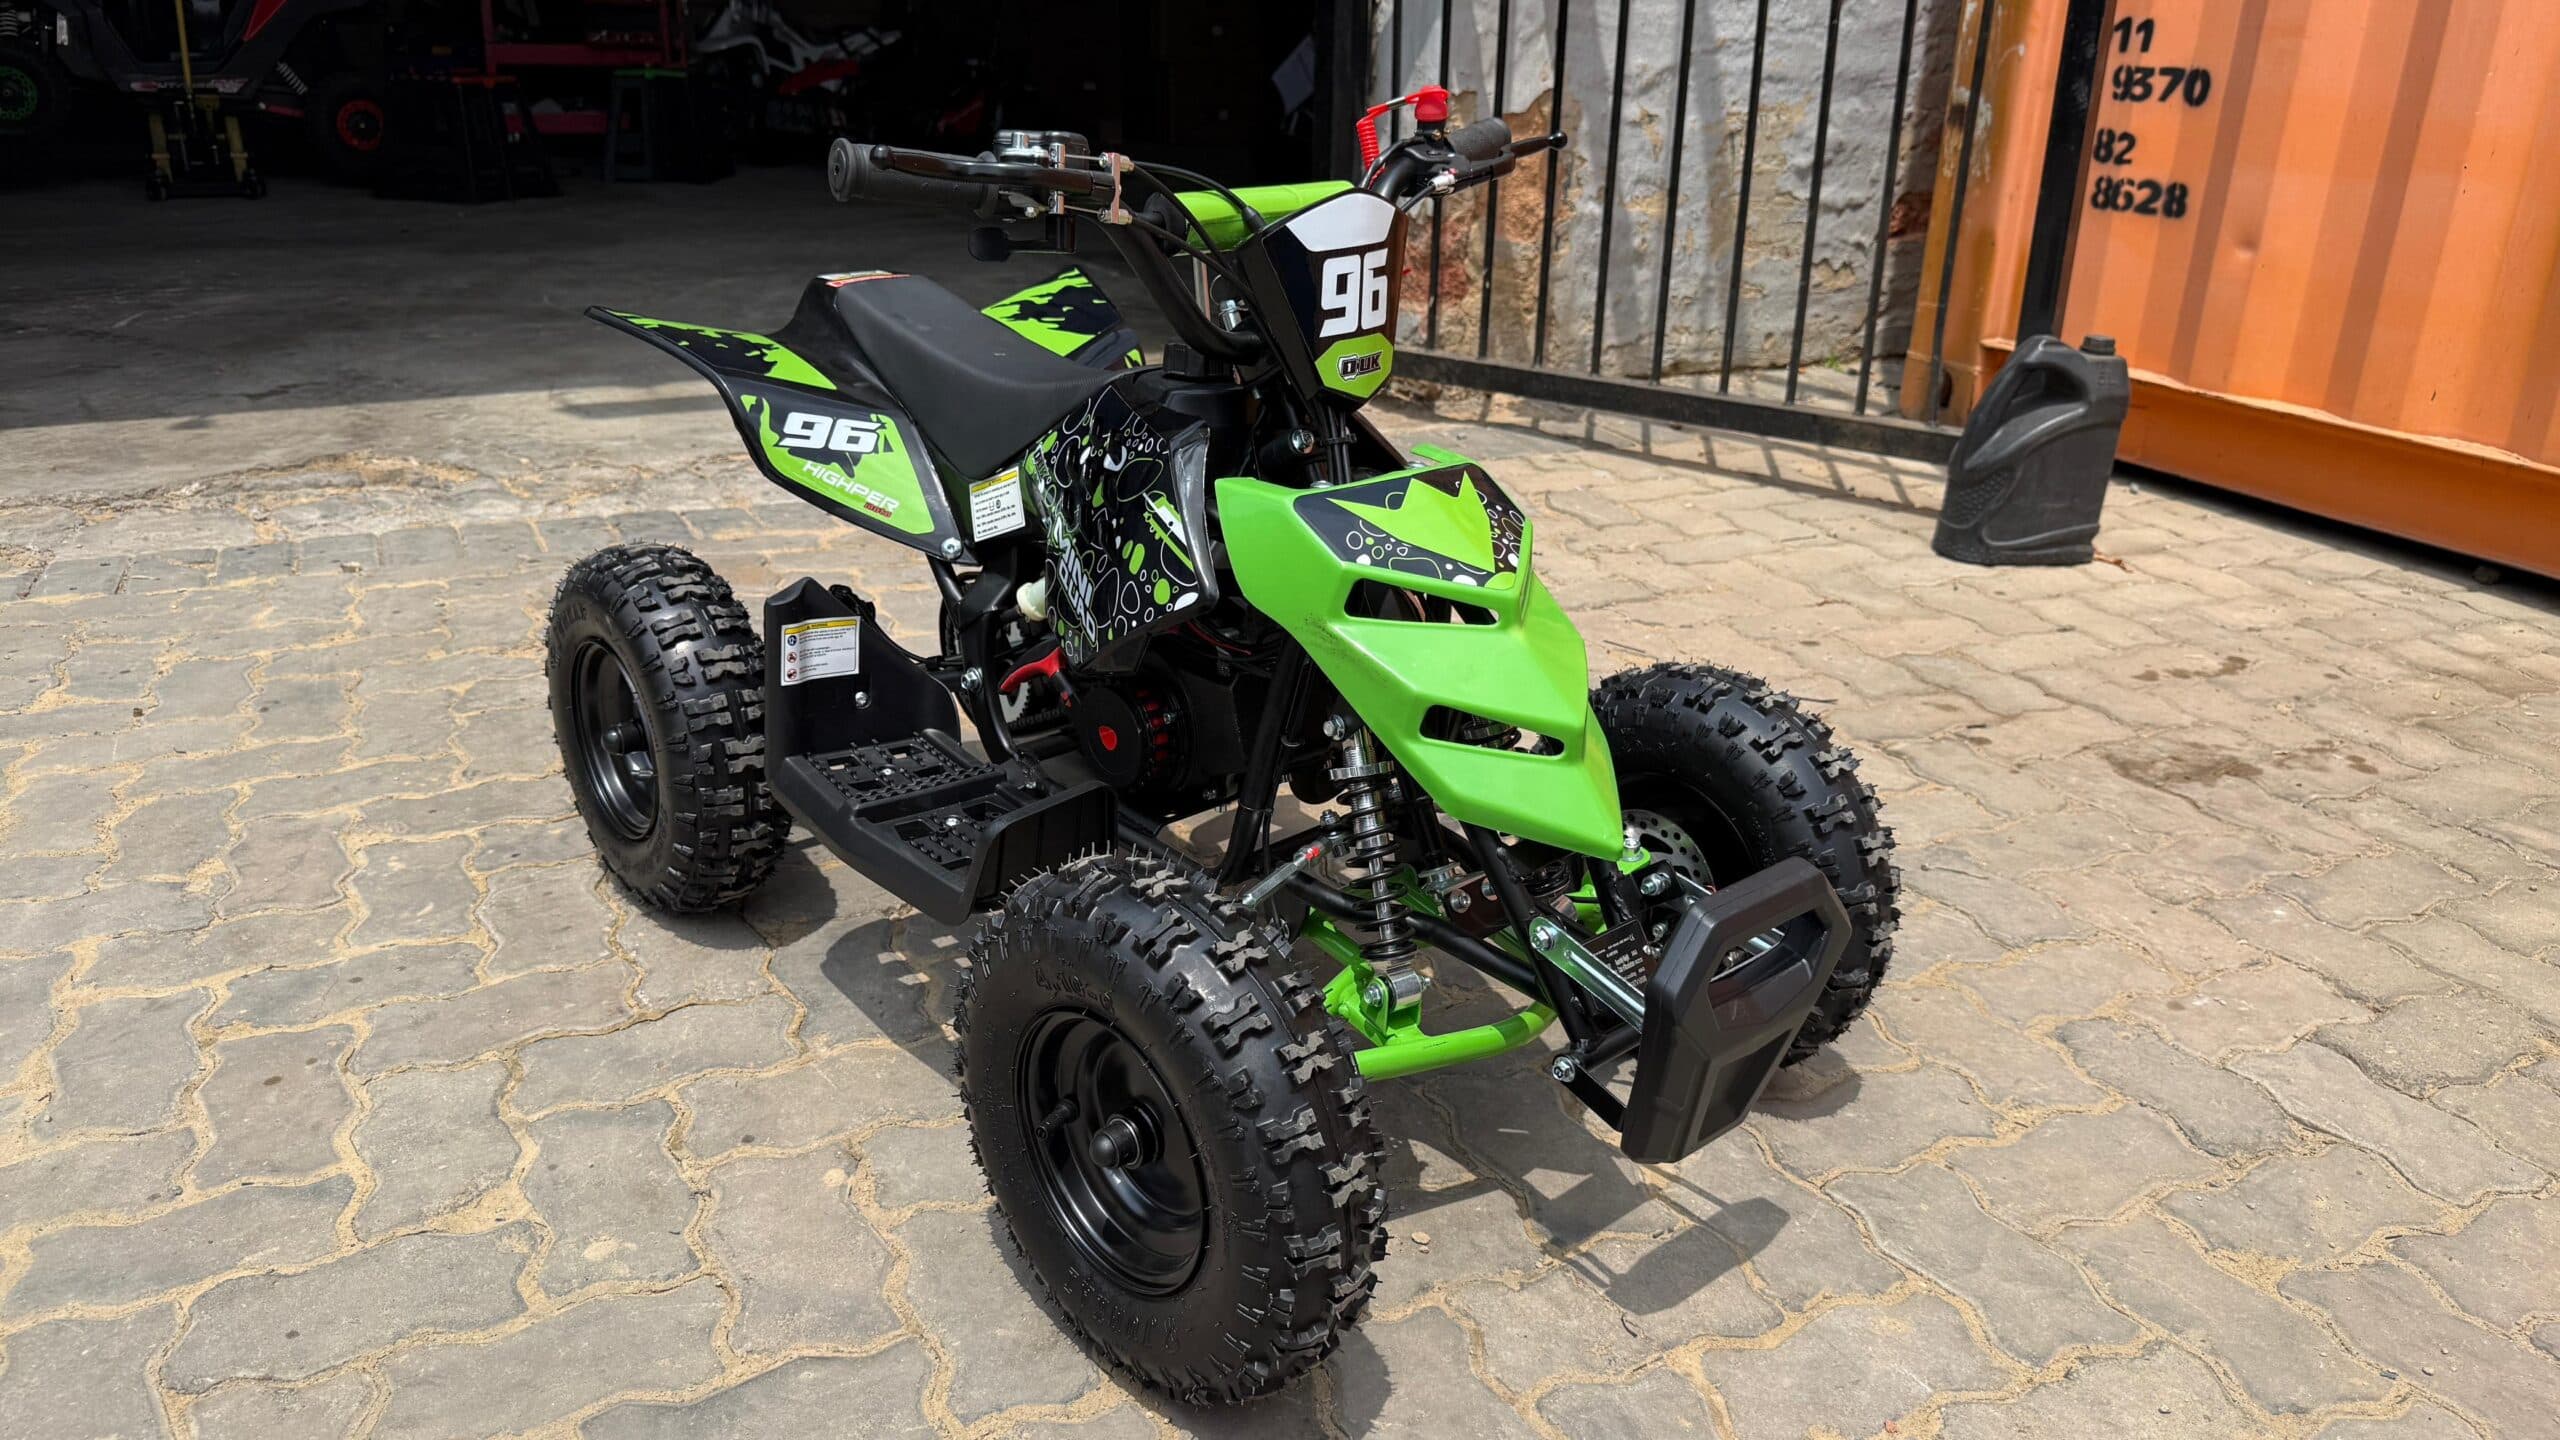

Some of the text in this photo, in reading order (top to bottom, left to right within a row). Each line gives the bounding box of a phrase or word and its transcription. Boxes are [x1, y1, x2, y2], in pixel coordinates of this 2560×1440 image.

[2113, 16, 2155, 53] 11
[2112, 65, 2212, 107] 9370
[2092, 128, 2136, 165] 82
[2090, 176, 2189, 219] 8628
[1318, 247, 1389, 338] 96
[778, 411, 882, 453] 96
[801, 459, 900, 512] HIGHPER
